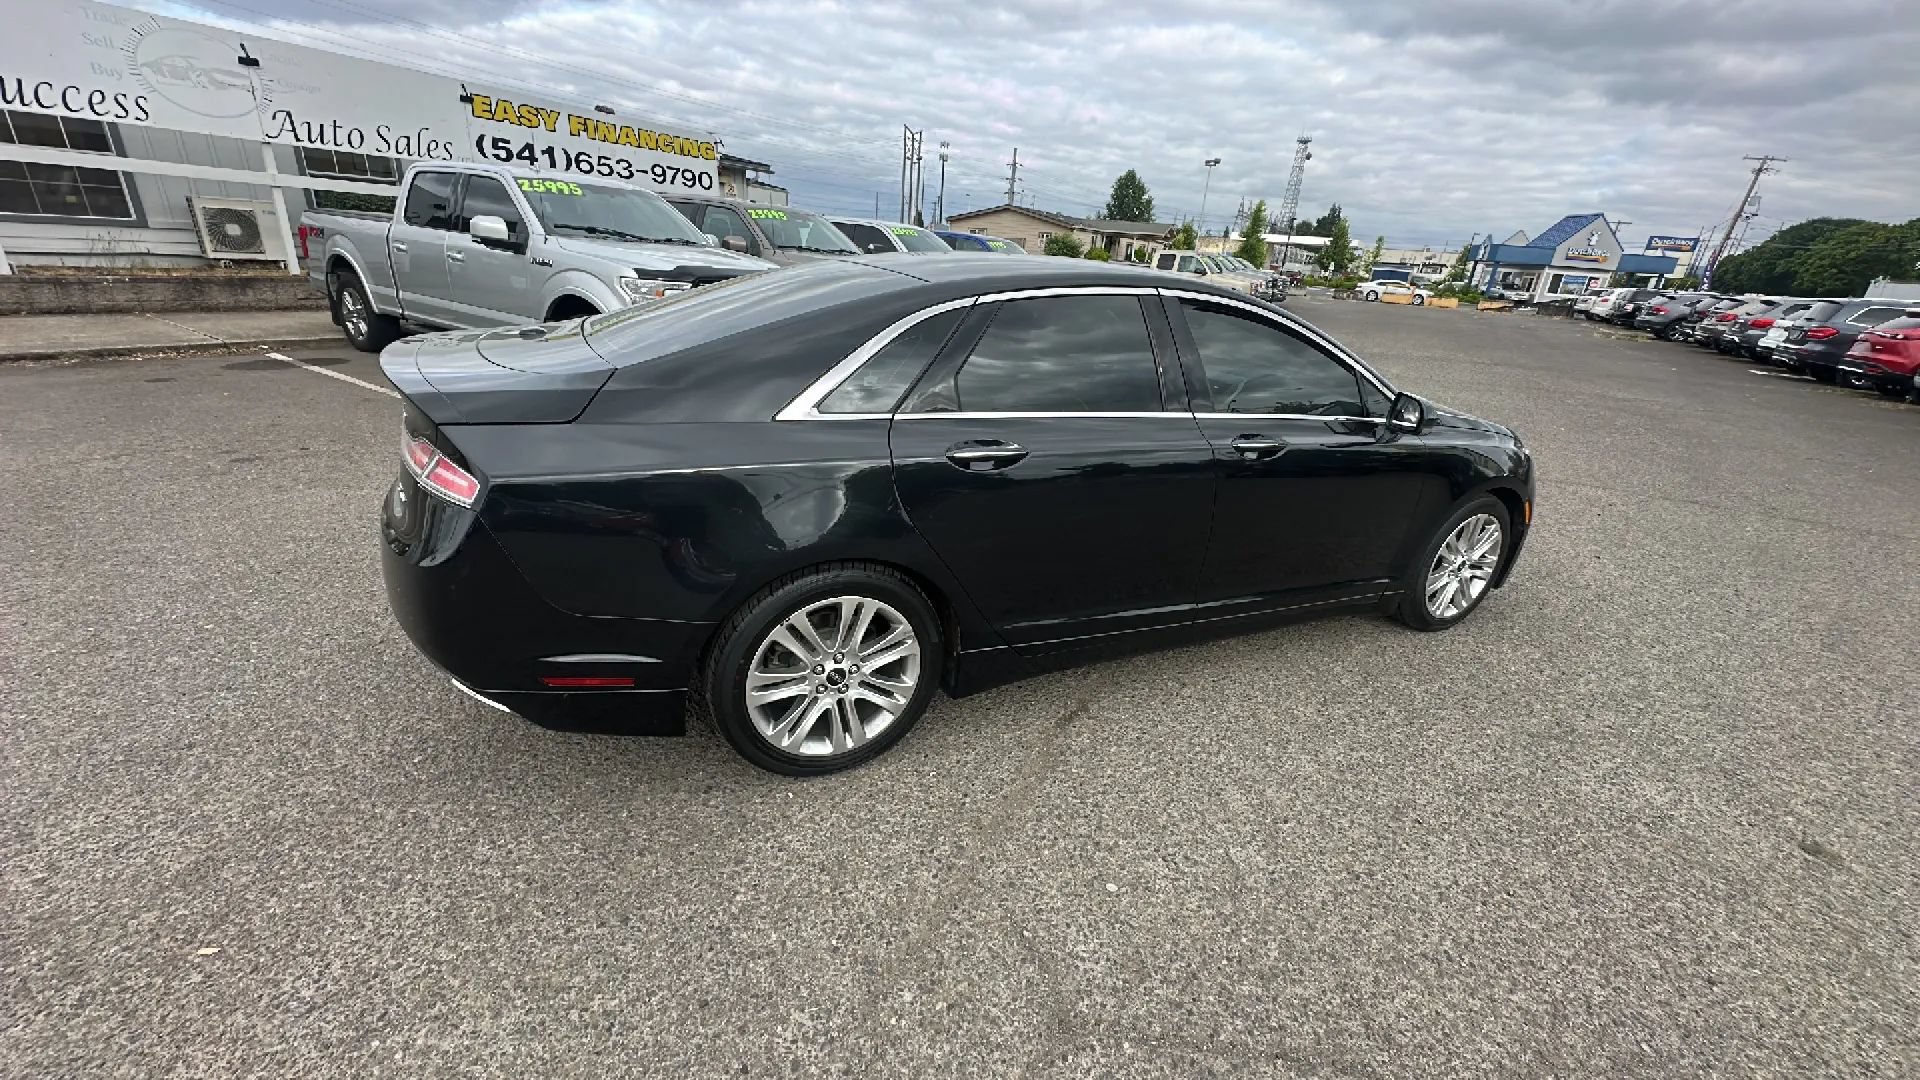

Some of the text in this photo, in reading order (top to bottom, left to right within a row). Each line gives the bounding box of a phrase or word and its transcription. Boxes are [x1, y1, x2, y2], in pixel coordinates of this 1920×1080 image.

[81, 32, 115, 49] Sell
[90, 60, 124, 81] Buy
[265, 109, 364, 149] Auto
[375, 124, 453, 161] Sales
[471, 93, 716, 160] EASY FINANCING
[475, 133, 713, 190] (541)653-9790
[517, 179, 583, 196] 25995
